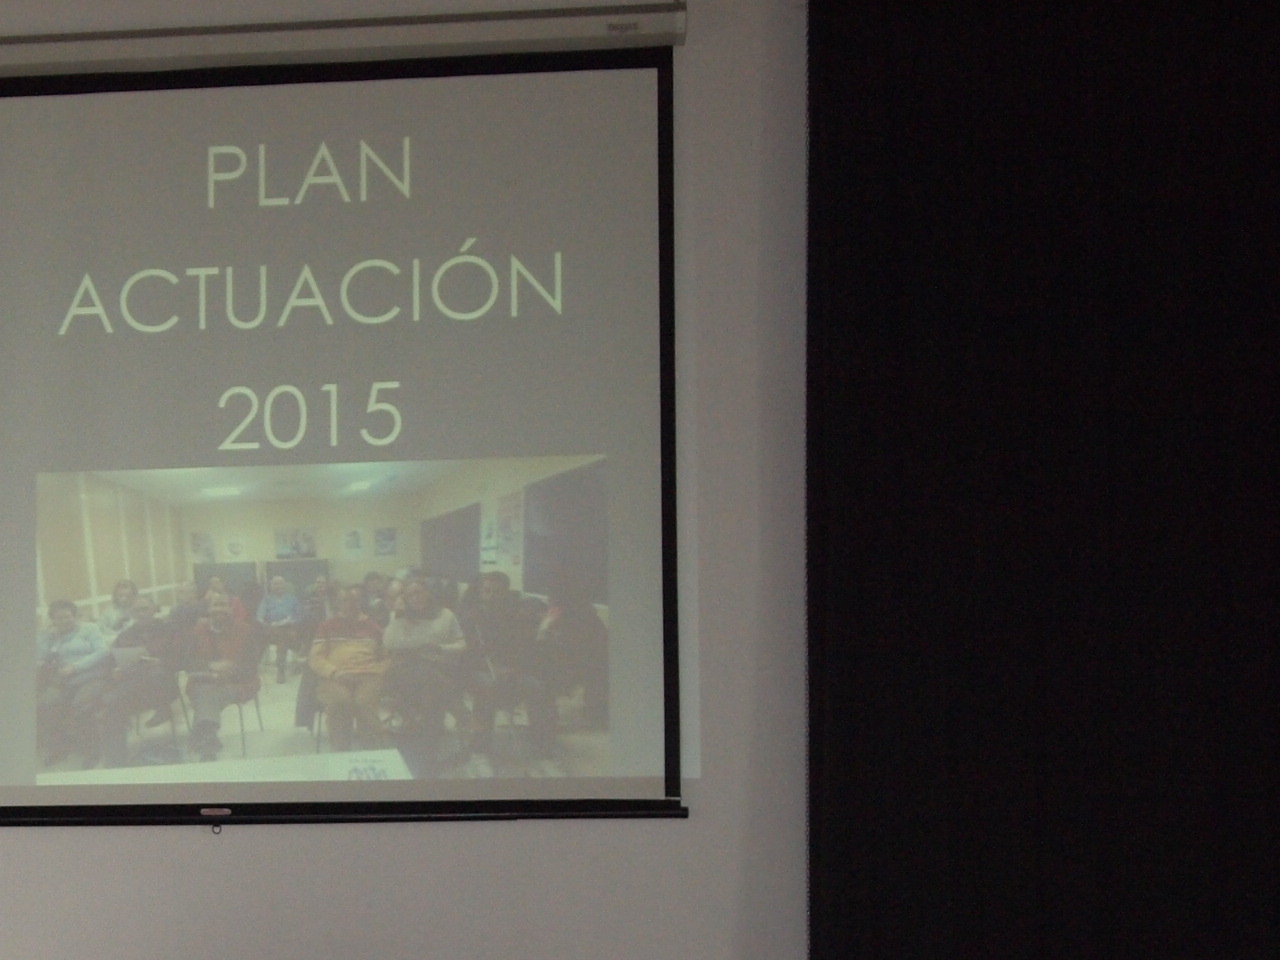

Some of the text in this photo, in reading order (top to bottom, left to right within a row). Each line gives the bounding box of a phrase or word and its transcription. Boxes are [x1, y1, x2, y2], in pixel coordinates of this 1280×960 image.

[207, 136, 411, 208] PLAN
[58, 237, 563, 335] ACTUACIÓN
[218, 381, 402, 450] 2015
